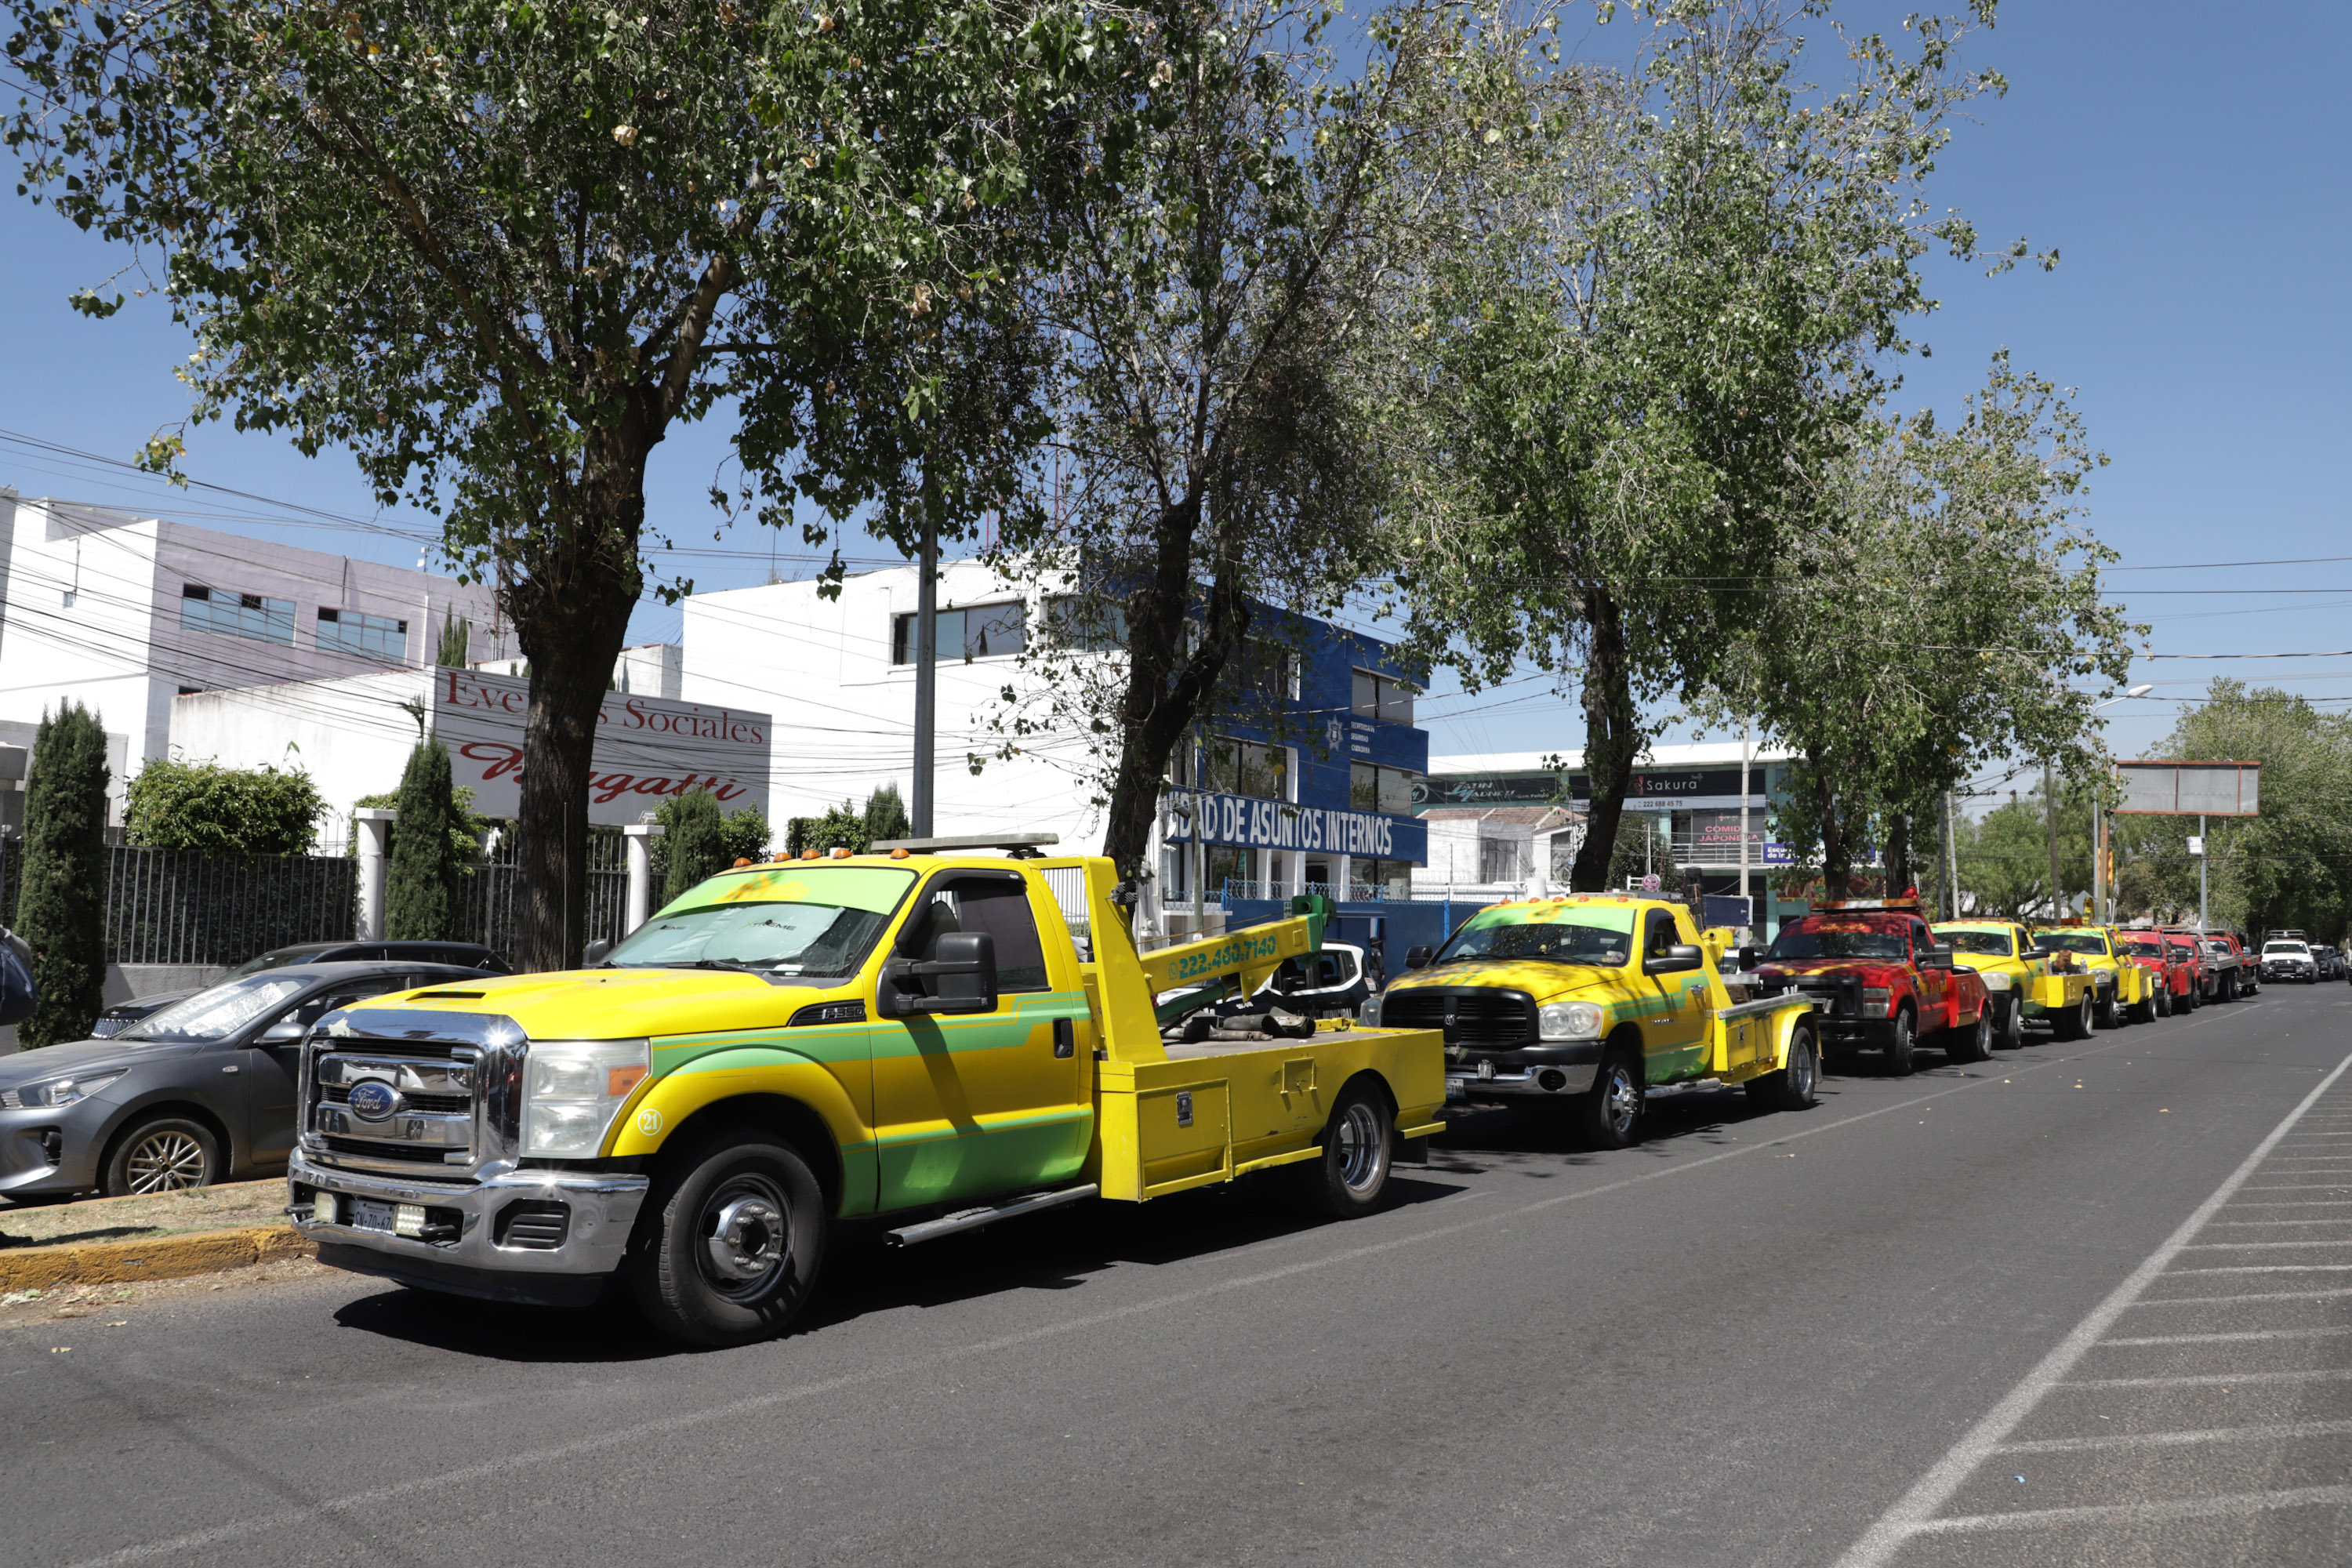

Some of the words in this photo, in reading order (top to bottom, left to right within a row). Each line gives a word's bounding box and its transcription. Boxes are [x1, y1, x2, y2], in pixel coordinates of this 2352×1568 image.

[445, 671, 608, 725] Eves
[624, 699, 763, 744] Sociales
[1646, 780, 1697, 790] Sakura
[1224, 797, 1245, 843] DE
[1250, 800, 1322, 850] ASUNTOS
[1326, 810, 1392, 856] INTERNOS
[1179, 935, 1276, 979] 222.460.7140
[355, 1088, 383, 1109] Ford
[643, 1112, 658, 1130] 21
